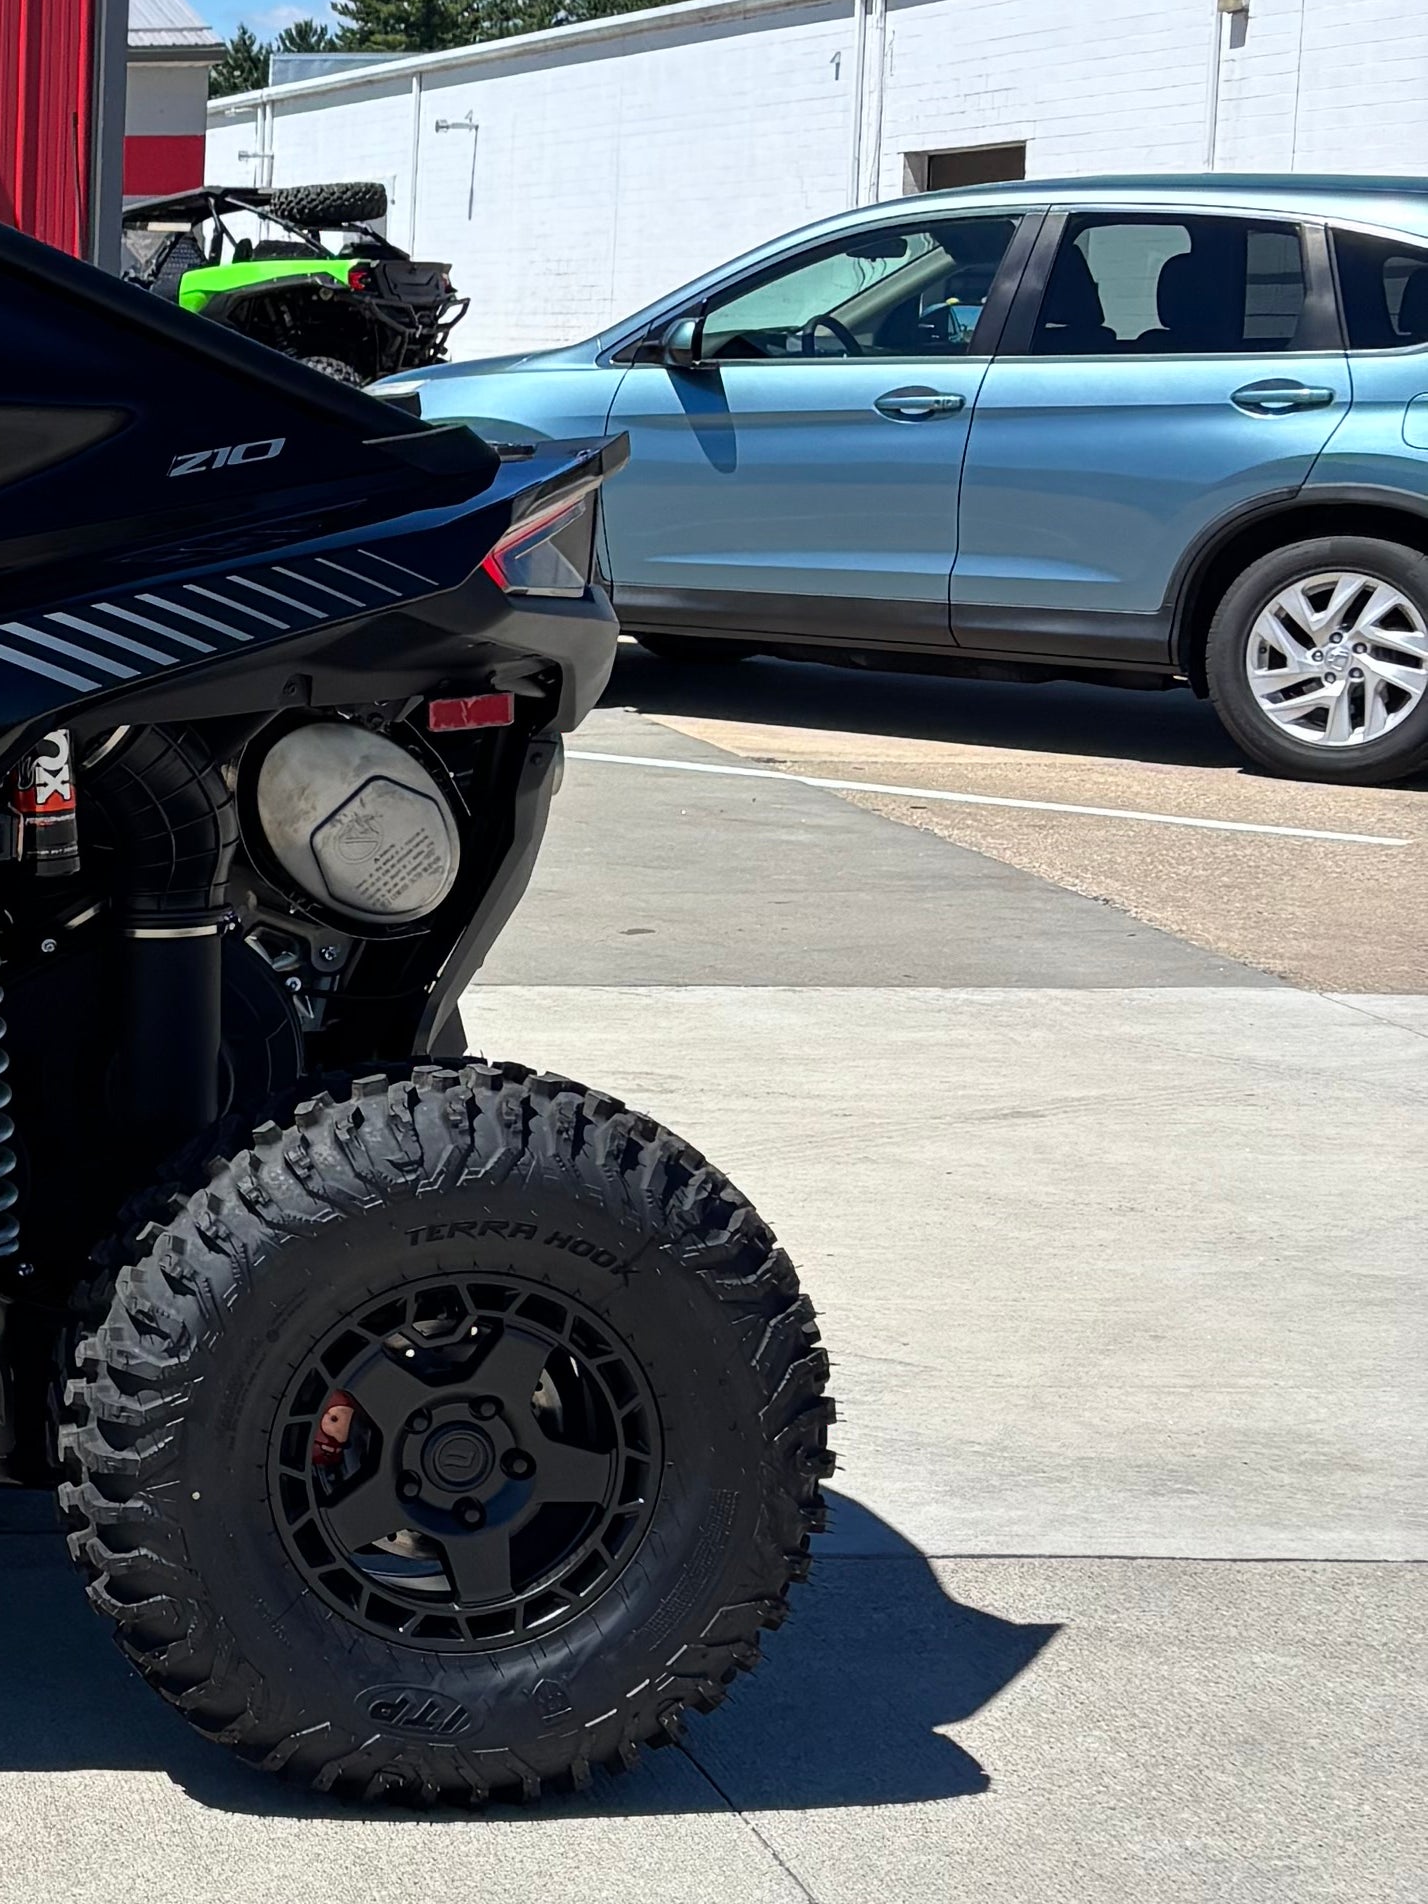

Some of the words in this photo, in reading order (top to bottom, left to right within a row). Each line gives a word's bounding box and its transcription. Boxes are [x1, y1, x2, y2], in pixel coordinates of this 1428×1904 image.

[168, 437, 286, 478] Z10
[34, 729, 72, 805] OX
[404, 1219, 539, 1246] TERRA
[544, 1231, 641, 1286] HOOK
